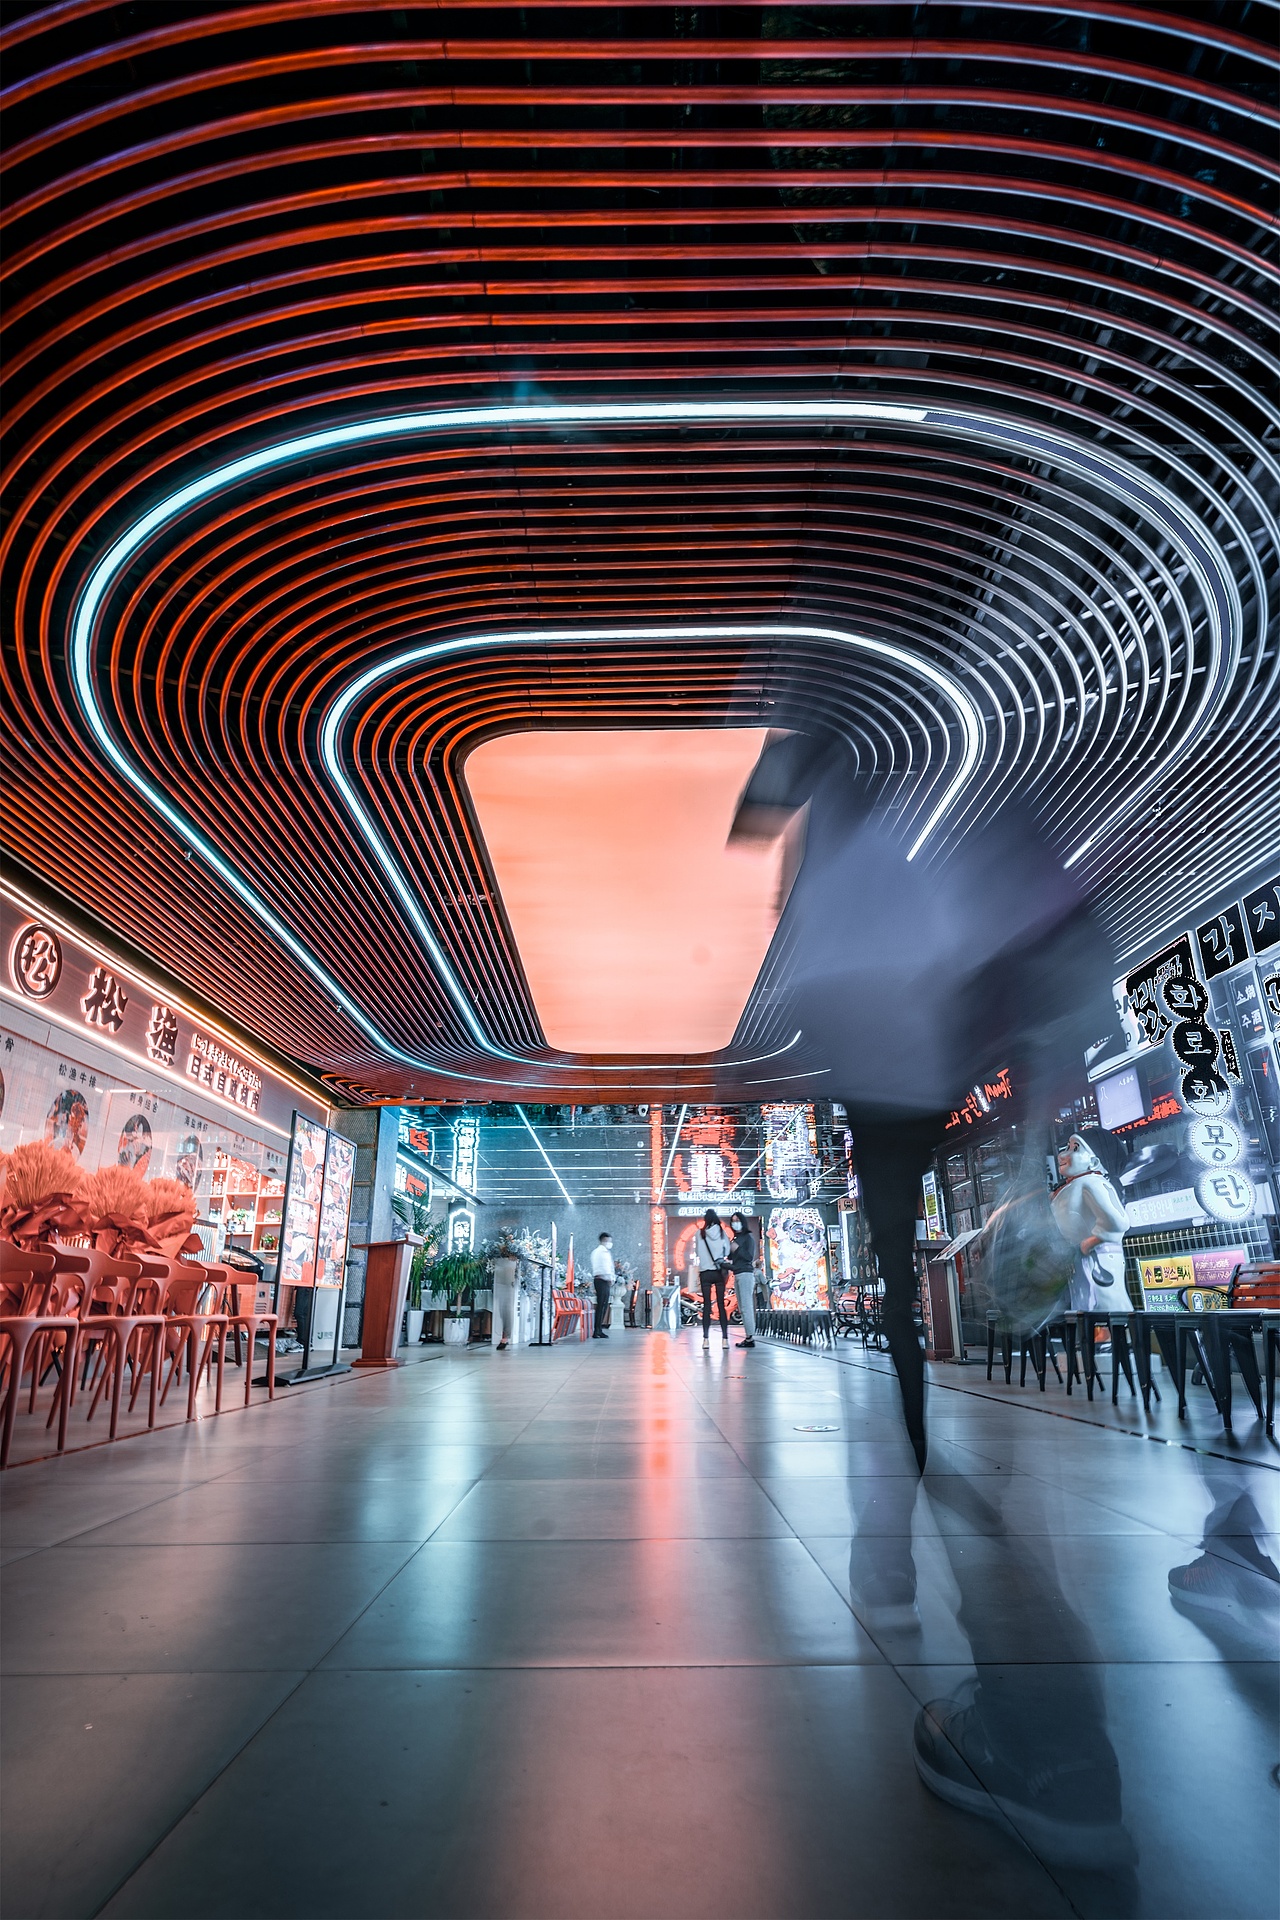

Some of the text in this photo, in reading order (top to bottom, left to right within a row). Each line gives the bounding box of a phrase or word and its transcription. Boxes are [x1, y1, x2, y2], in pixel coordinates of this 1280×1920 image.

[58, 1063, 97, 1088] 松渔牛排
[1168, 983, 1246, 1210] 화로화몽탄
